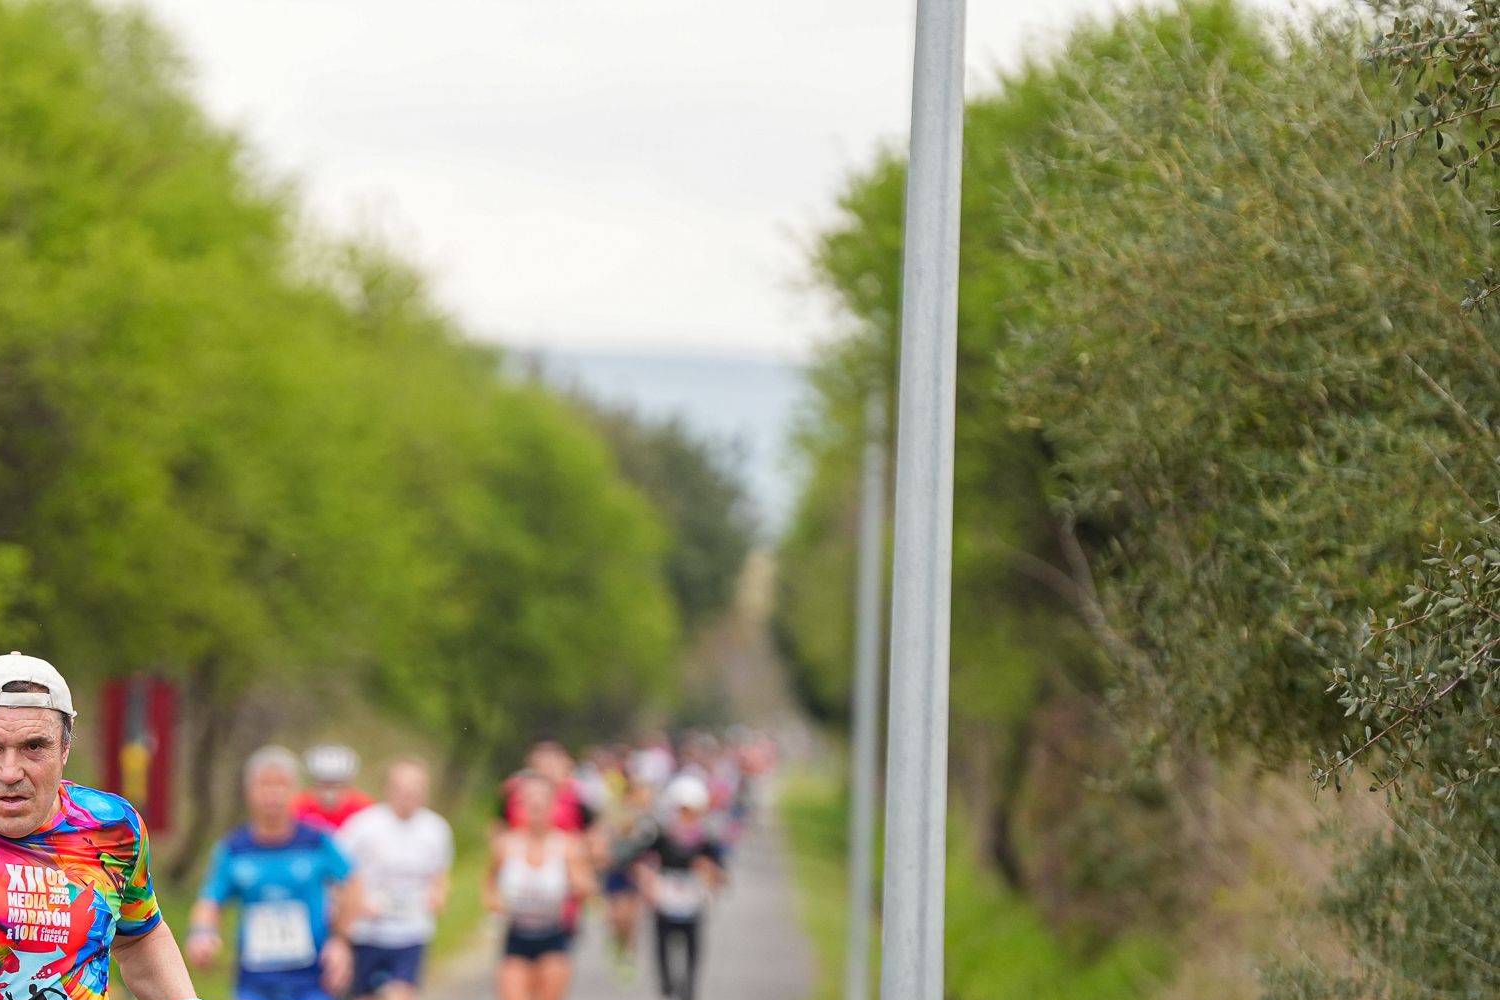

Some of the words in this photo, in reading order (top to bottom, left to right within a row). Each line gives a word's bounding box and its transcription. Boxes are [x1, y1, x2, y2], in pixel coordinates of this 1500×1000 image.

[5, 864, 47, 893] XII
[46, 867, 68, 886] 08
[7, 891, 48, 910] MEDIA
[8, 908, 71, 927] MARATÓN
[6, 928, 13, 940] &
[15, 925, 39, 940] 10K
[40, 934, 68, 944] LUCENA
[41, 927, 61, 935] Ciudad
